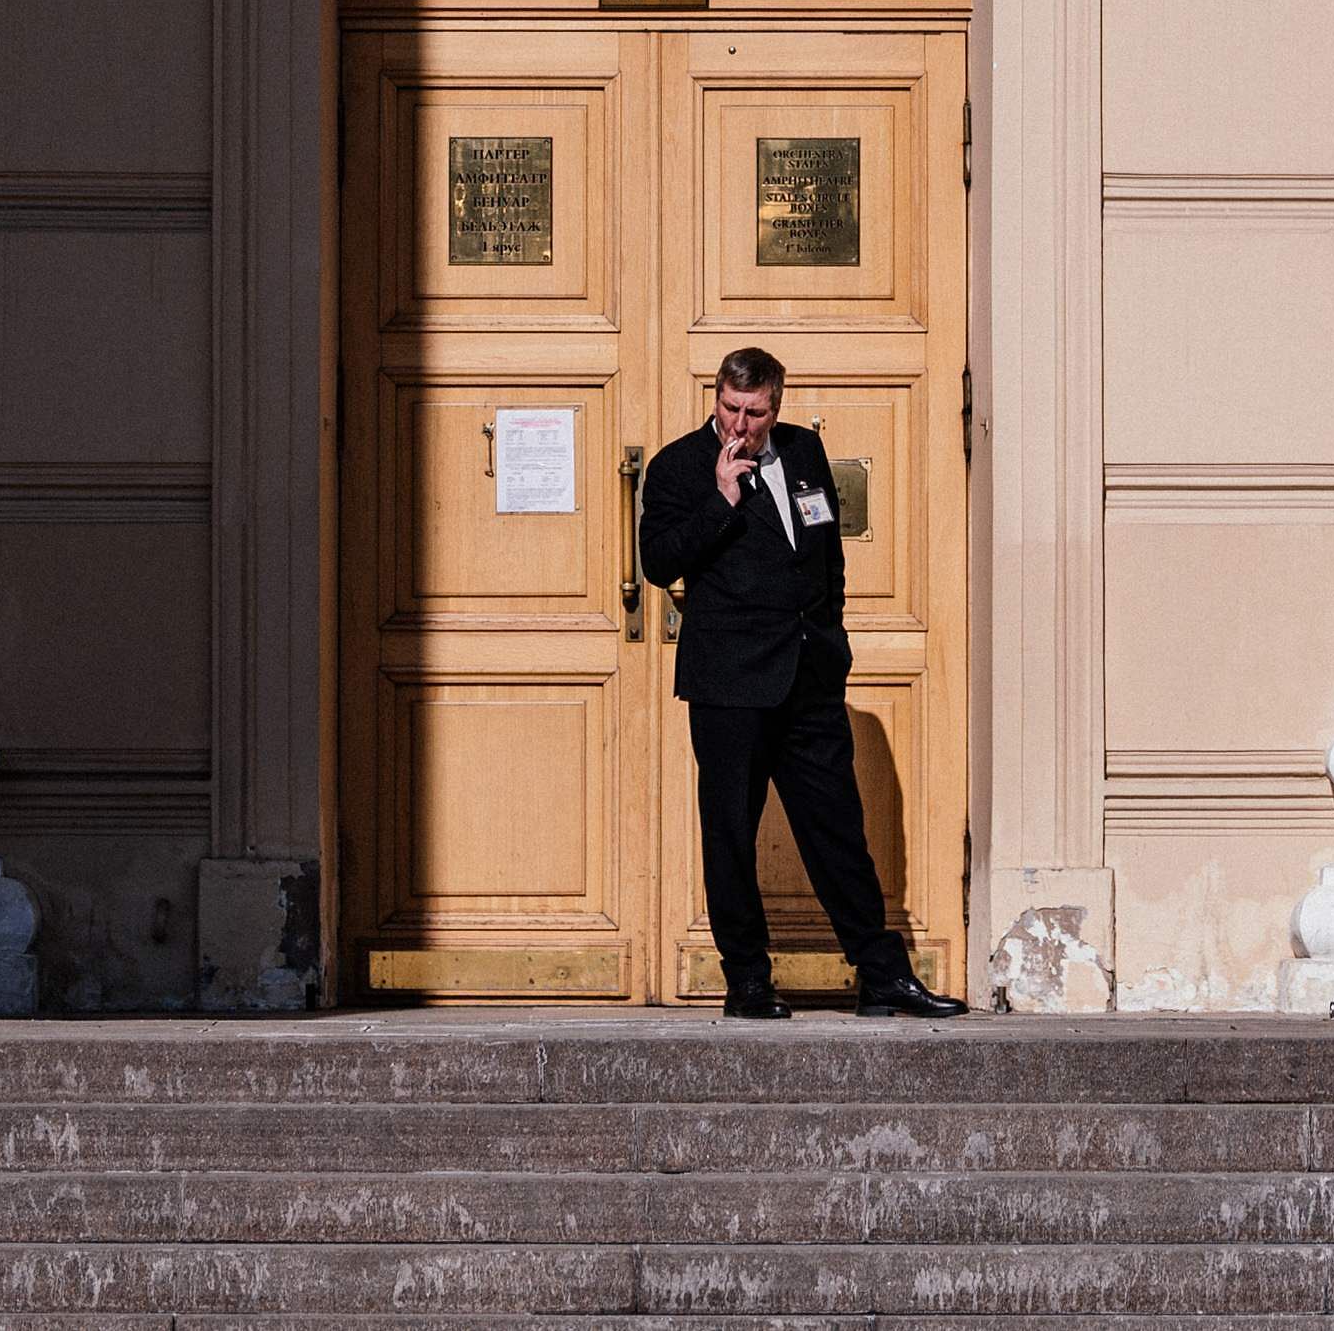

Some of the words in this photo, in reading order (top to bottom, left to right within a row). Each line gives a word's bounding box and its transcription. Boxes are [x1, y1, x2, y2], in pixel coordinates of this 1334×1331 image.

[472, 149, 530, 160] ПАРТЕР
[772, 150, 844, 160] ORCHESTRA
[455, 173, 548, 184] АМФИТЕАТР
[472, 196, 530, 208] БЕНУАР
[789, 203, 828, 214] BOXES
[789, 229, 828, 239] BOXES
[492, 244, 522, 256] ярус
